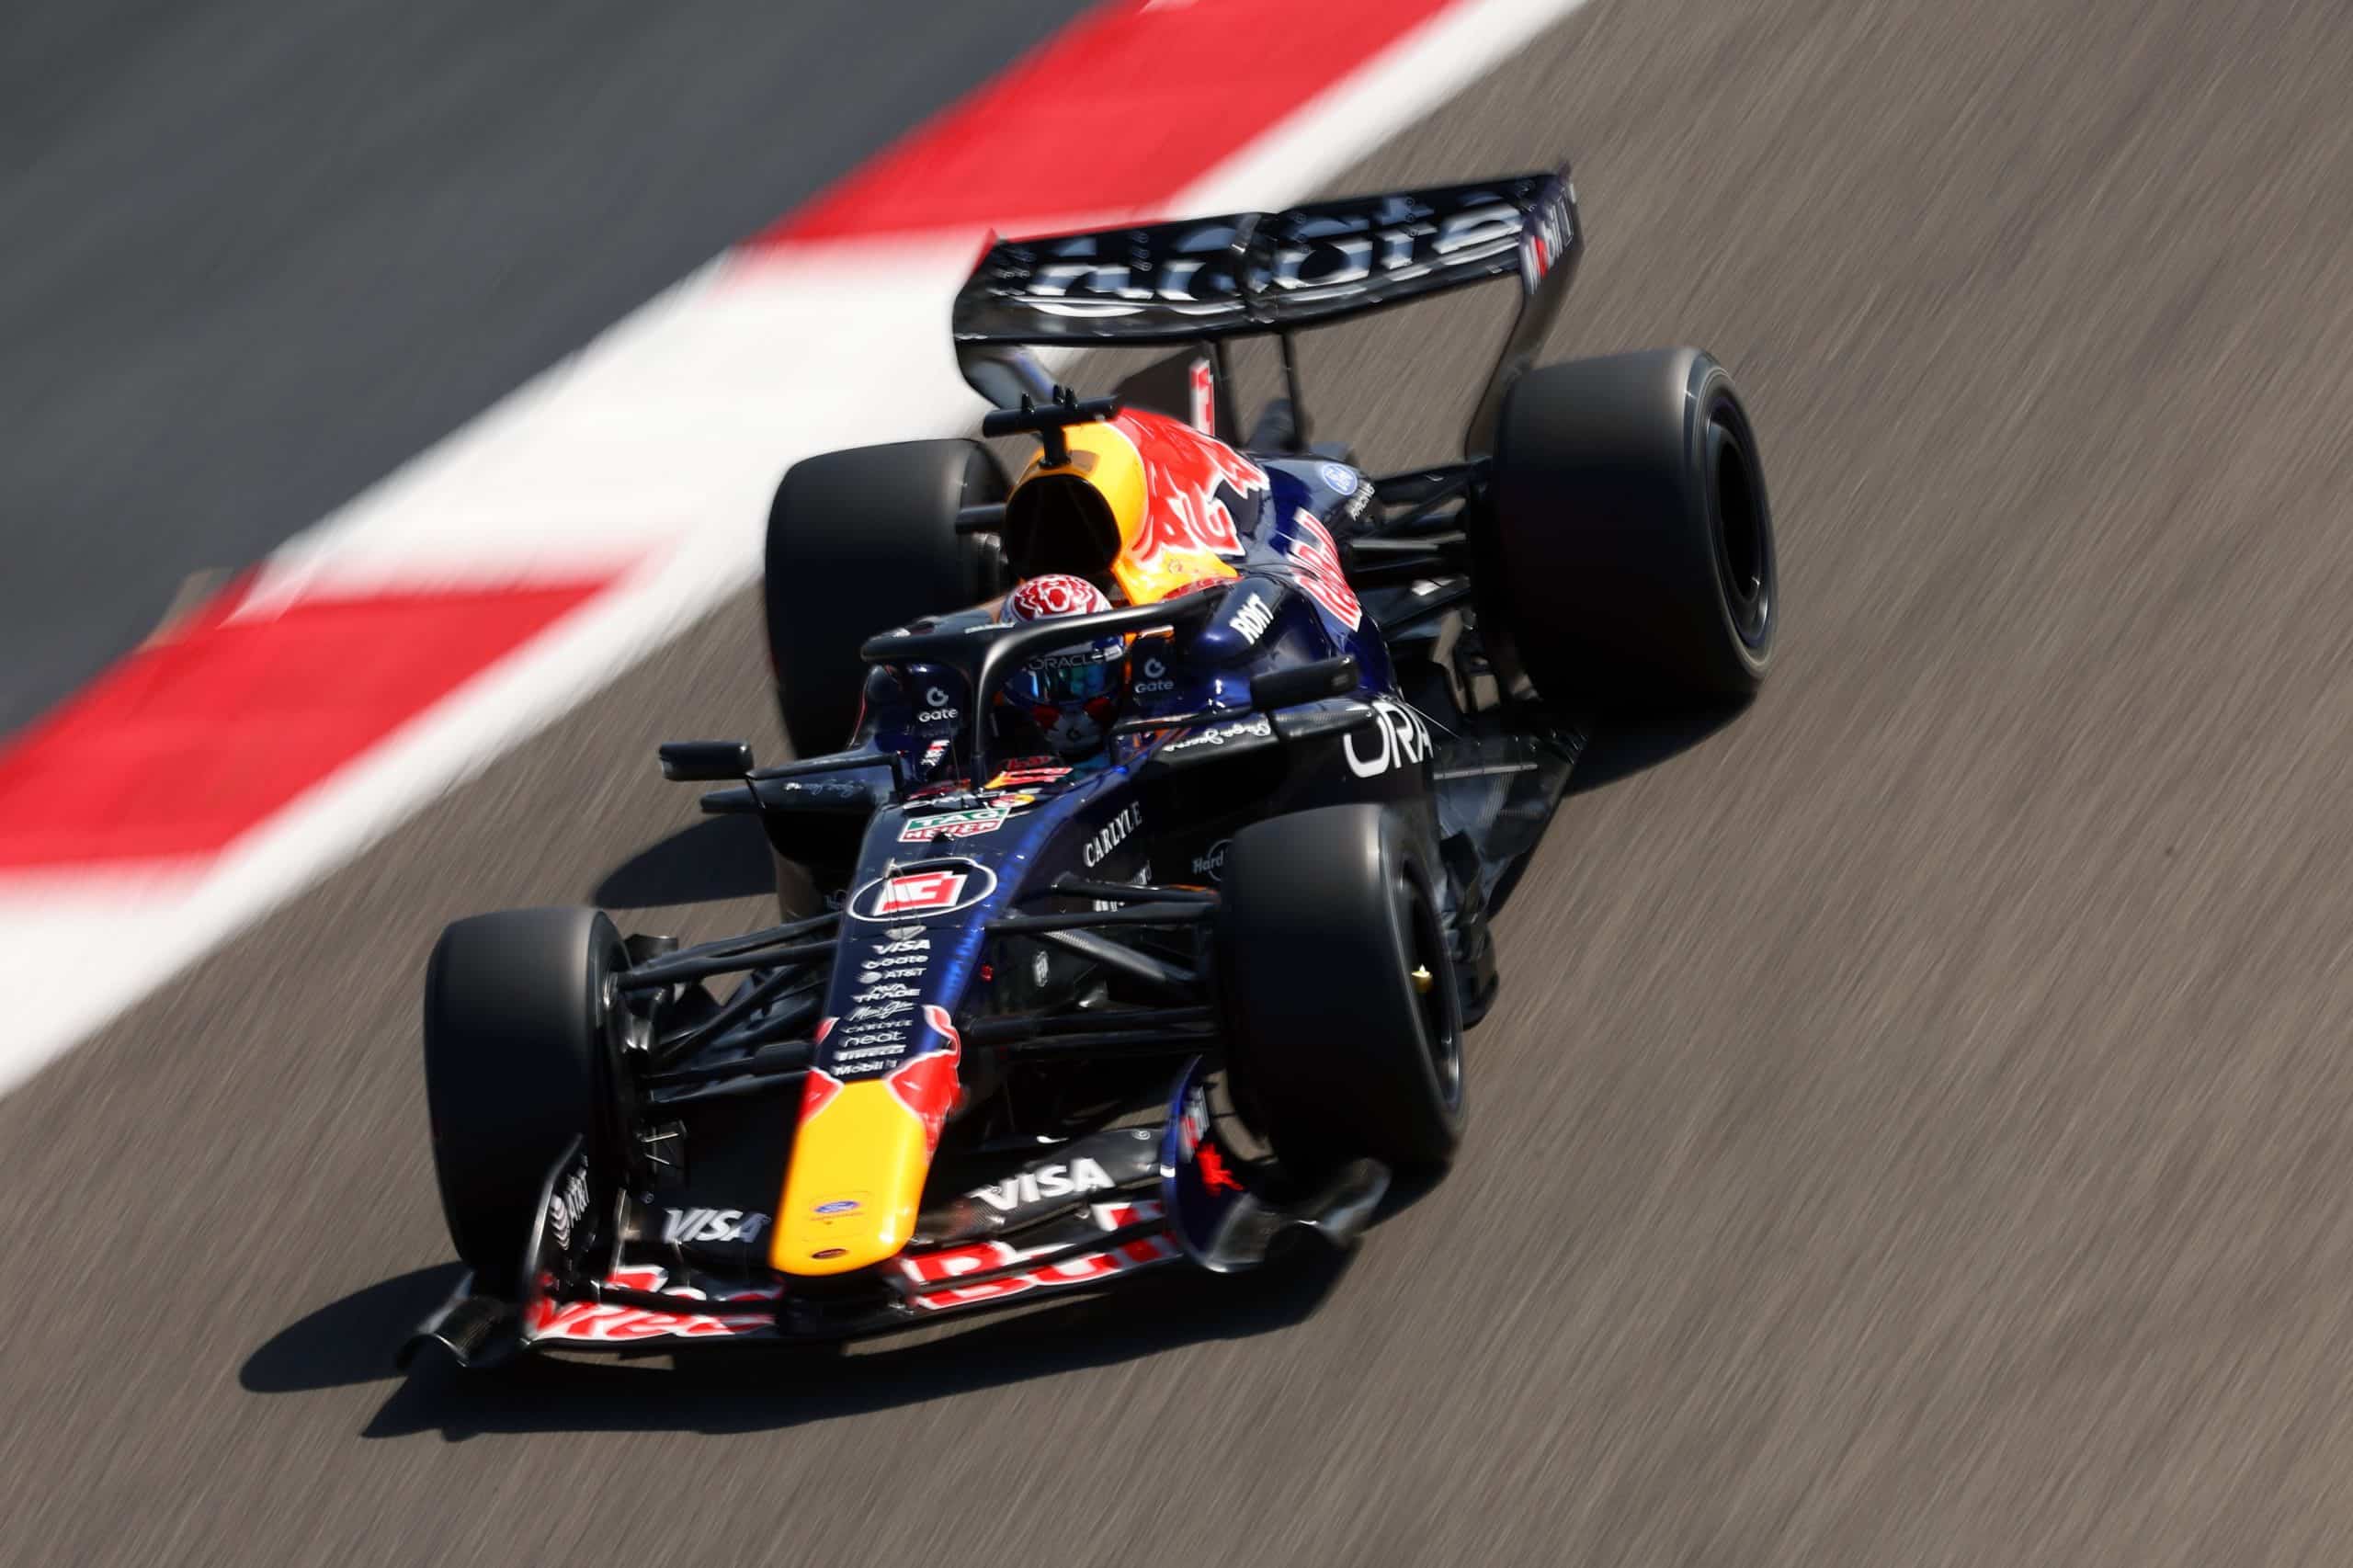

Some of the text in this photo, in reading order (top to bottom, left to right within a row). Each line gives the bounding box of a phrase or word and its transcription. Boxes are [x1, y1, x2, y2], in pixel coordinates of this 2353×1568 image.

[1229, 593, 1274, 645] ROKT
[1134, 679, 1175, 694] Gate
[918, 708, 958, 723] Gate
[920, 808, 999, 826] TAG
[1084, 801, 1142, 868] CARLYLE
[1193, 849, 1224, 875] Hard
[871, 939, 931, 954] VISA
[840, 1030, 907, 1048] neat
[831, 1061, 884, 1076] Mobil
[965, 1157, 1116, 1211] VISA
[663, 1206, 772, 1244] VISA
